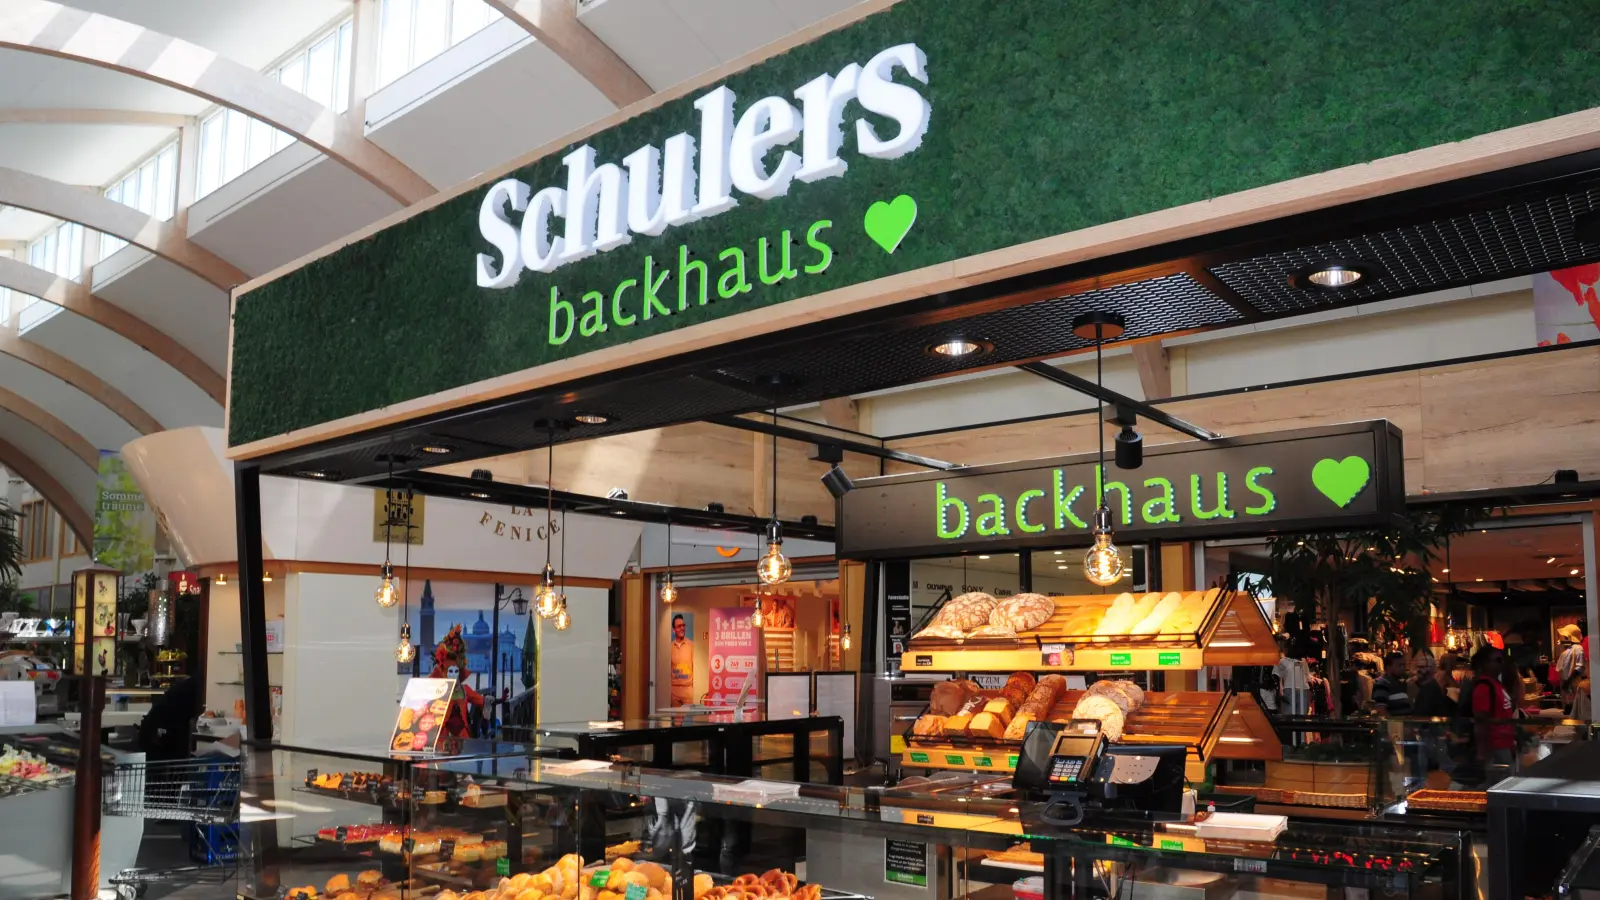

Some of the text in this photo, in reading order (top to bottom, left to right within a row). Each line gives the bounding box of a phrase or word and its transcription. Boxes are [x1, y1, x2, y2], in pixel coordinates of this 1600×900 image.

[477, 43, 931, 289] Schulers
[548, 219, 835, 346] backhaus
[101, 491, 145, 500] Somme
[935, 465, 1277, 538] backhaus
[511, 504, 533, 517] LA
[479, 511, 561, 542] FENICE
[926, 583, 953, 592] OLYMPUS
[961, 585, 984, 593] SONY
[714, 616, 752, 631] 1+1=3
[720, 631, 752, 640] BRILLEN
